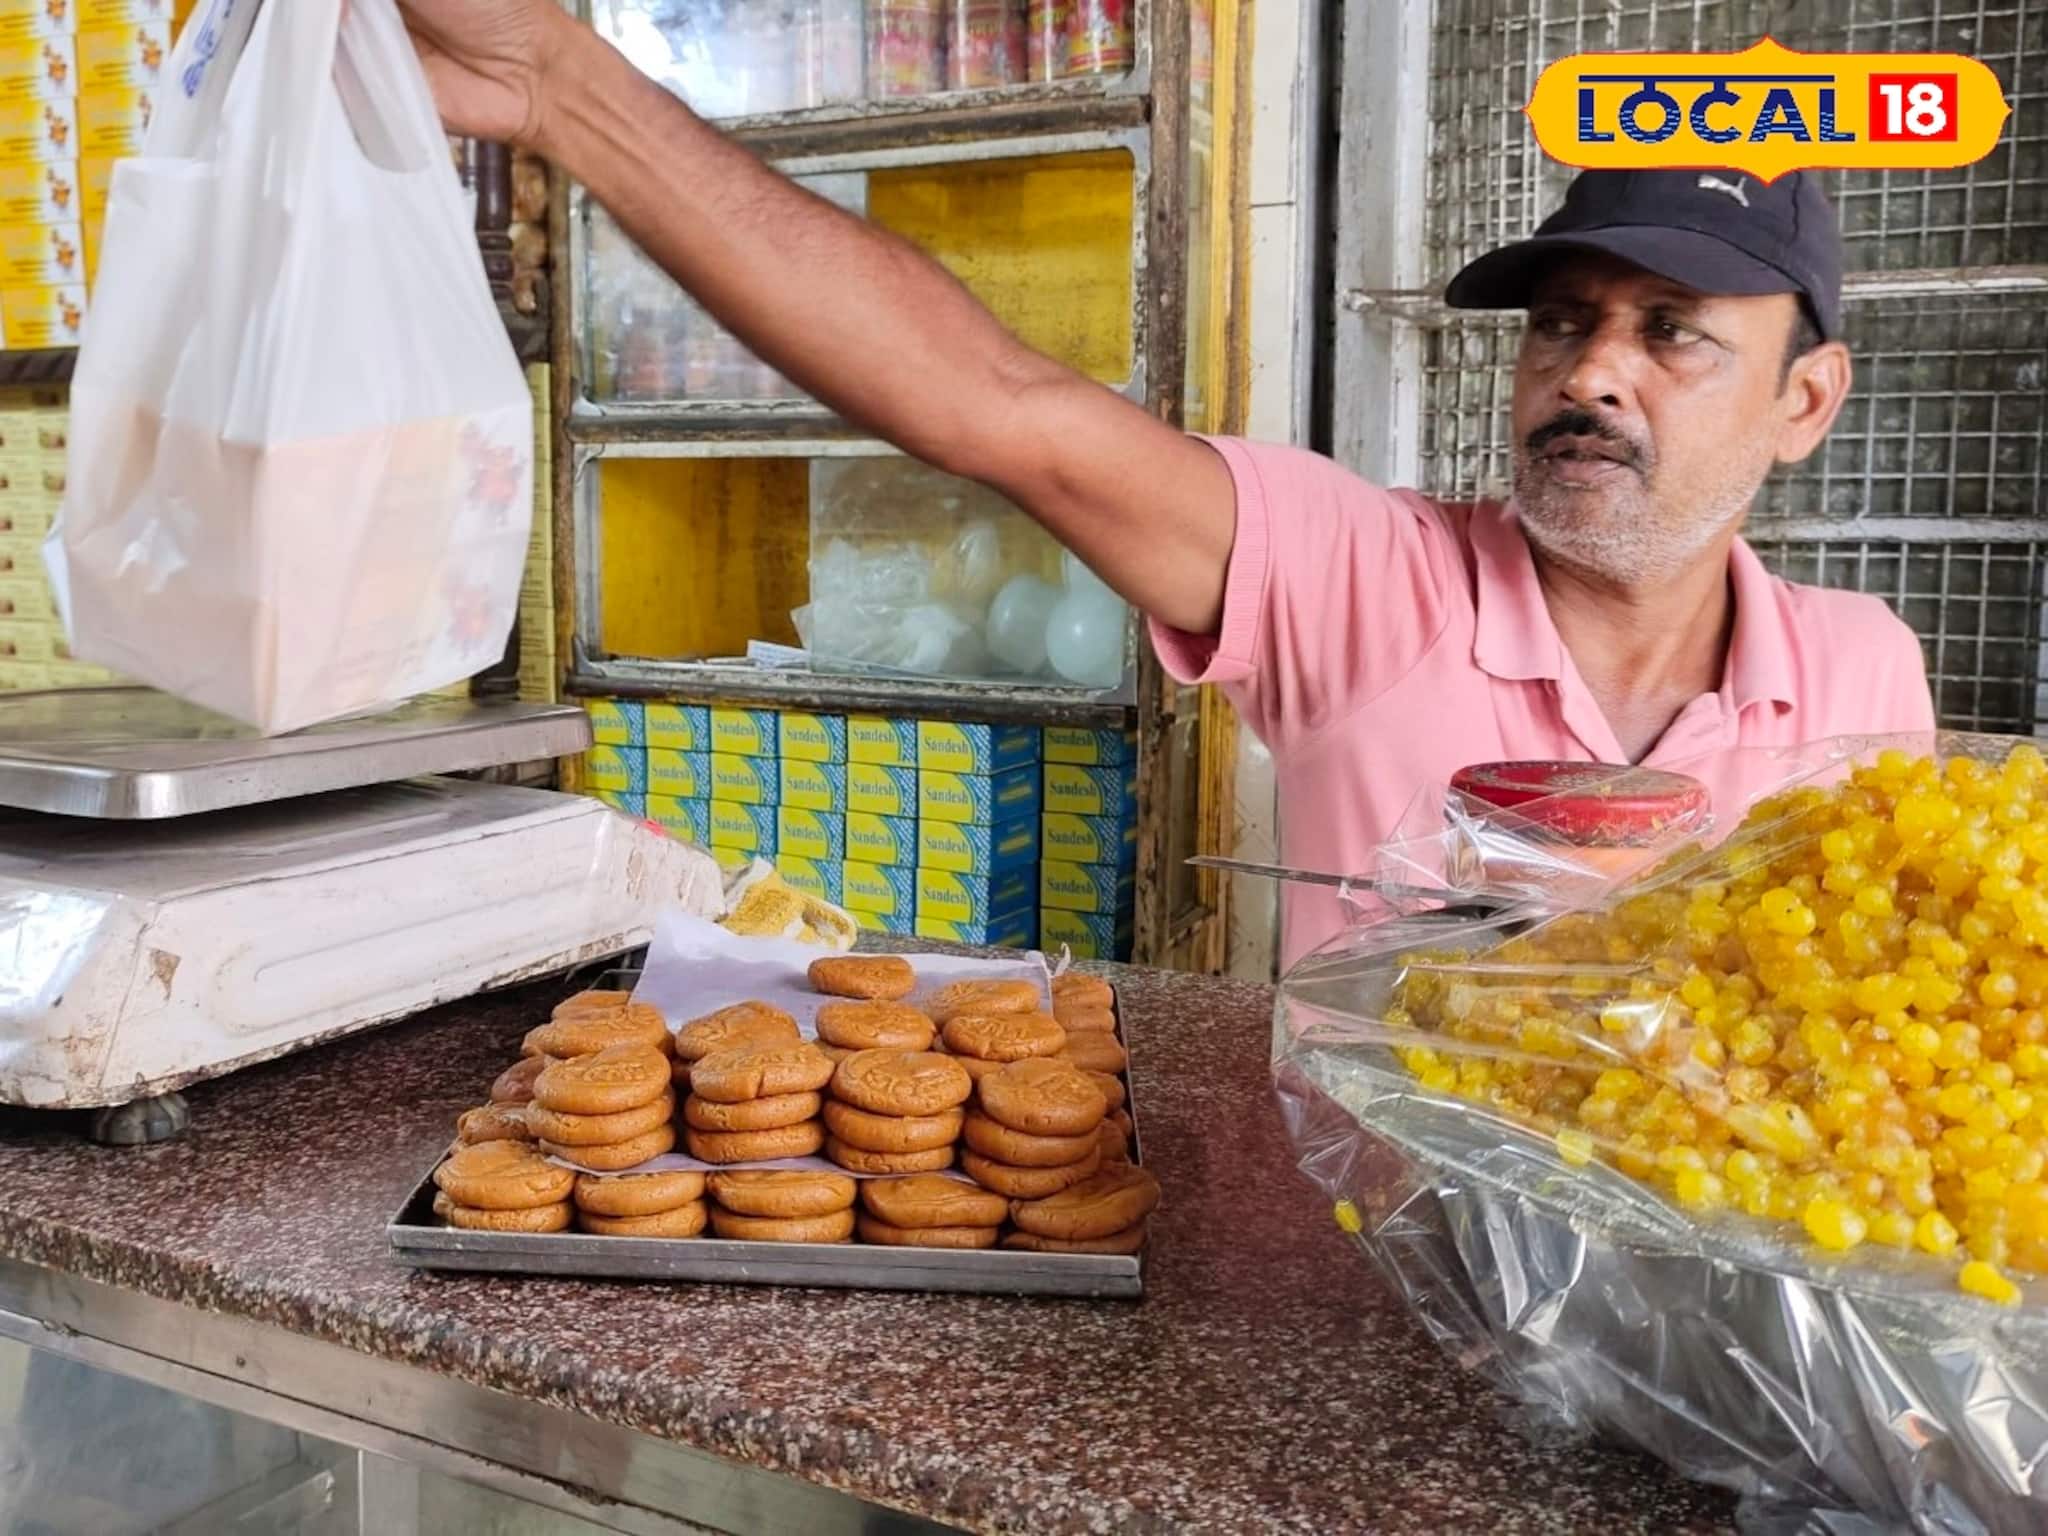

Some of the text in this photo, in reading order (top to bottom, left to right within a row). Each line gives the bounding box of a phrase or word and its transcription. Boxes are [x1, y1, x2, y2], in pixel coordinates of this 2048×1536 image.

[650, 717, 689, 731] Sandesh
[717, 722, 756, 736] Sandesh
[785, 728, 826, 743] Sandesh
[852, 728, 895, 742] Sandesh
[1048, 730, 1094, 746] Sandesh
[925, 738, 969, 753] Sandesh
[588, 761, 625, 776] Sandesh
[652, 765, 690, 778] Sandesh
[716, 771, 757, 785] Sandesh
[787, 777, 829, 792] Sandesh
[852, 779, 895, 795] Sandesh
[1050, 782, 1097, 798] Sandesh
[926, 789, 969, 804] Sandesh
[715, 815, 754, 830] Sandesh
[785, 823, 824, 839] Sandesh
[851, 828, 893, 844] Sandesh
[1048, 828, 1095, 844] Sandesh
[926, 838, 969, 854] Sandesh
[849, 880, 891, 896] Sandesh
[1048, 878, 1094, 894] Sandesh
[922, 888, 968, 904] Sandesh
[1046, 926, 1091, 943] Sandesh
